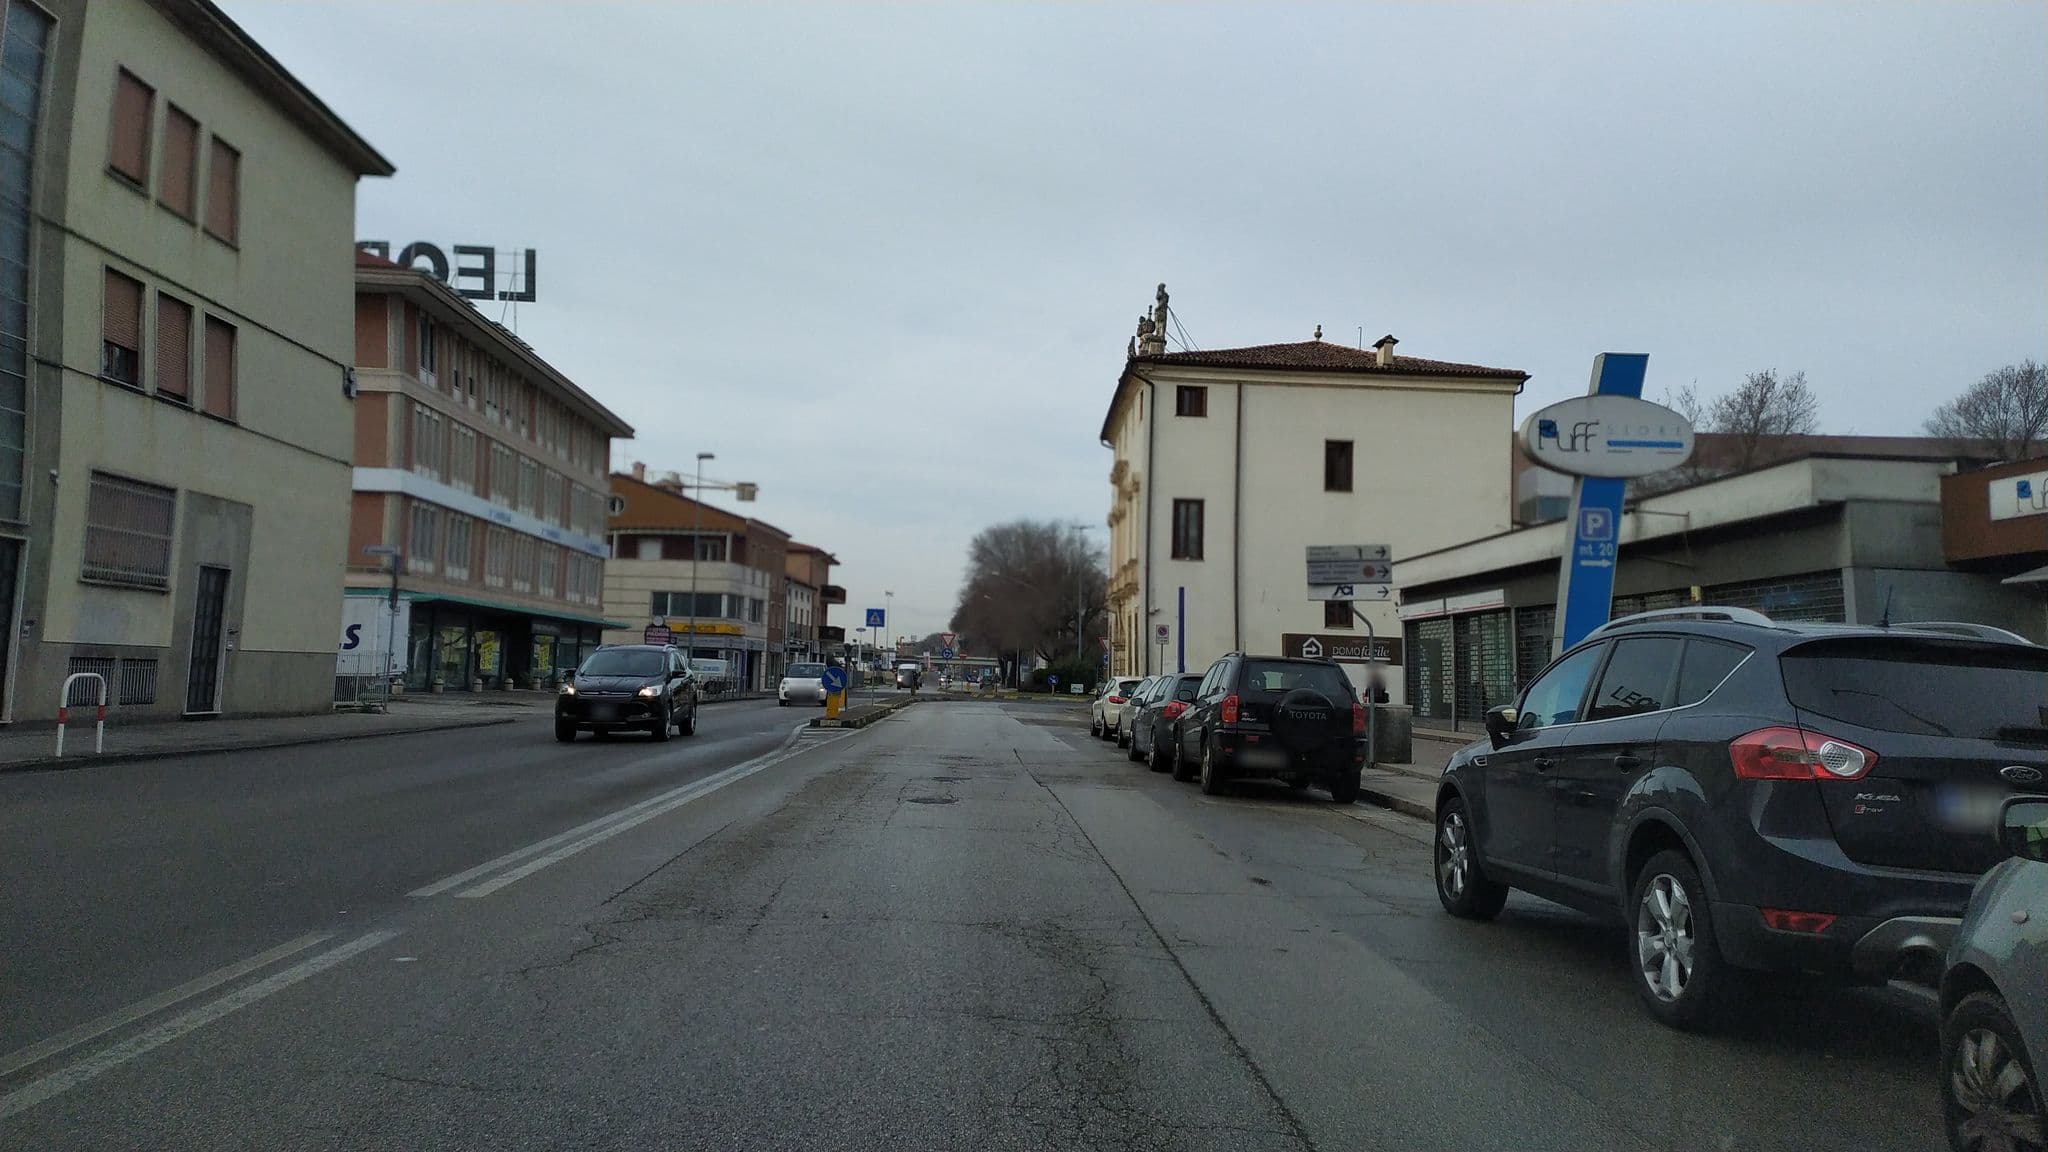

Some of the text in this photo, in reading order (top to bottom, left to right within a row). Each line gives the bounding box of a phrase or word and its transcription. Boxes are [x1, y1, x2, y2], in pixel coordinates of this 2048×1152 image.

[1539, 419, 1600, 452] Puff
[1587, 512, 1604, 535] P
[1600, 543, 1613, 556] 20
[1290, 711, 1327, 720] TOYOTA
